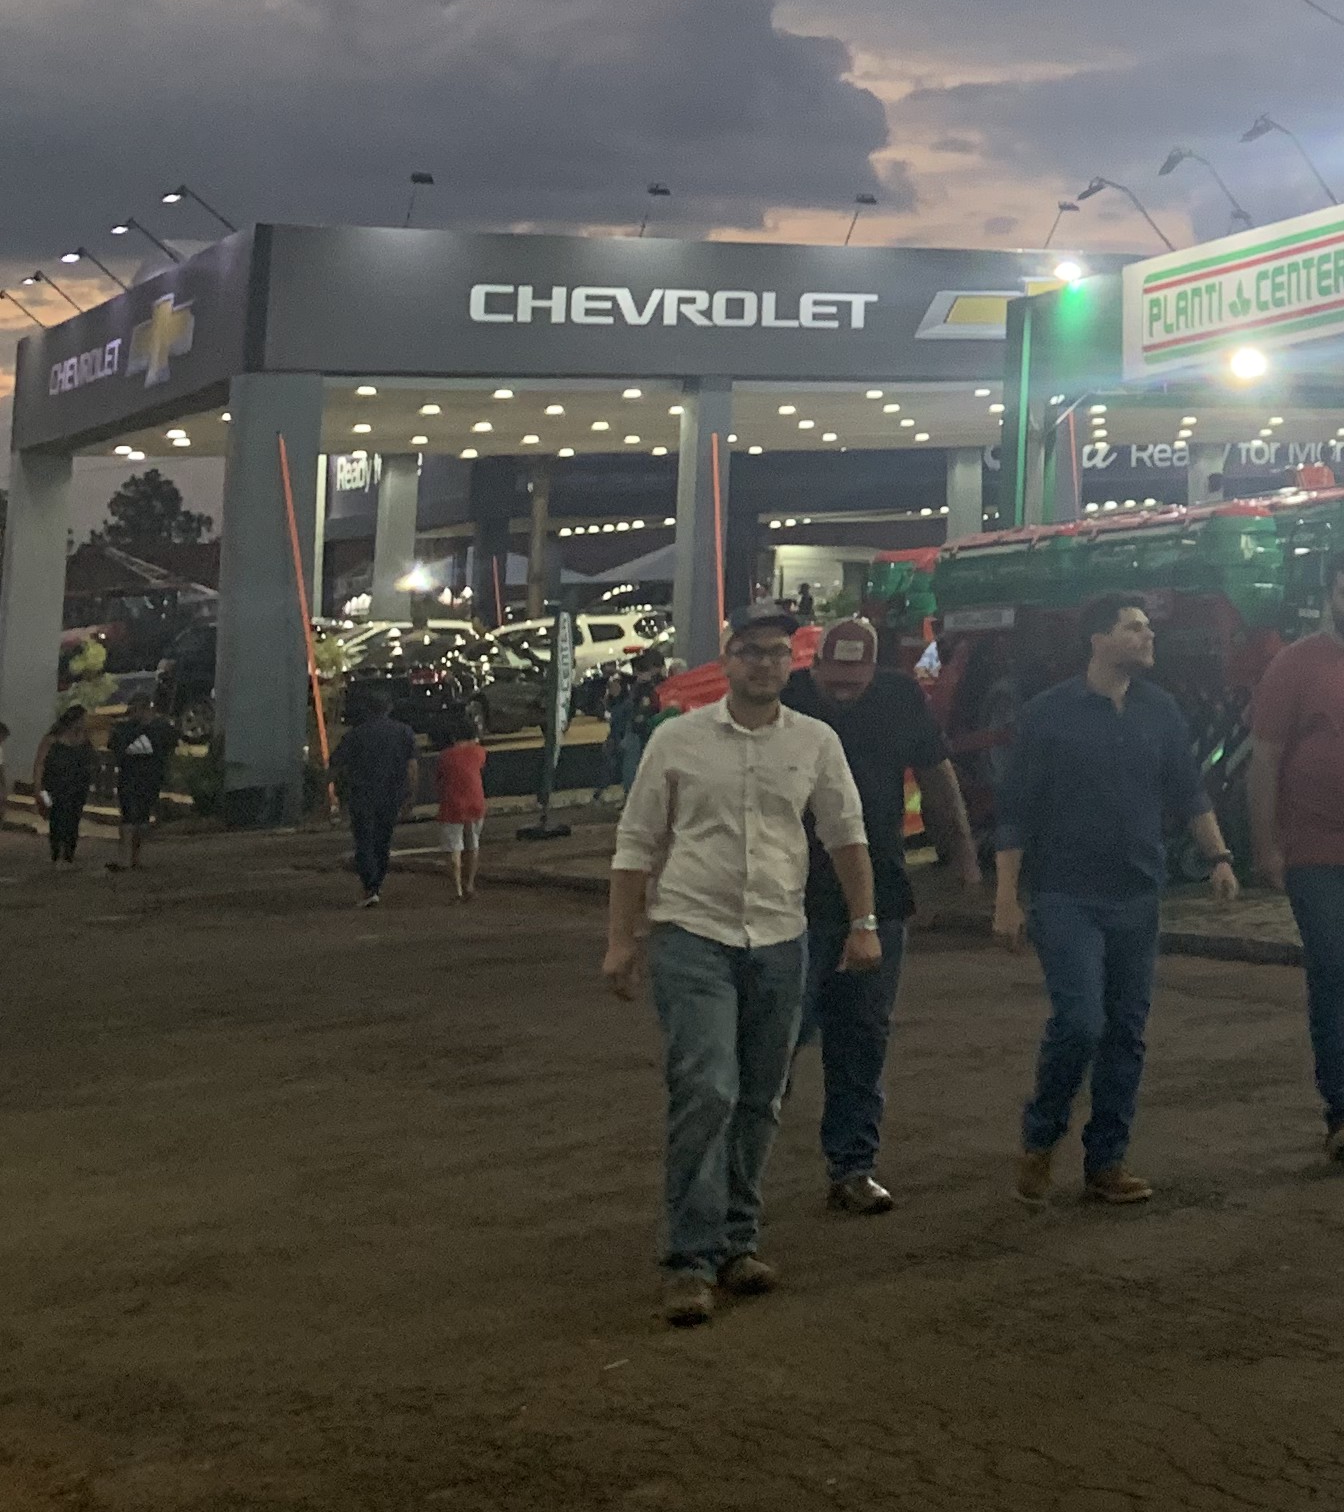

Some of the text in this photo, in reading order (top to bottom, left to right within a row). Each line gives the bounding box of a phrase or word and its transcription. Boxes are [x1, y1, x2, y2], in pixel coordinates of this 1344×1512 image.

[469, 284, 879, 329] CHEVROLET
[1149, 281, 1223, 338] PLANTI
[49, 338, 122, 395] CHEVROLET
